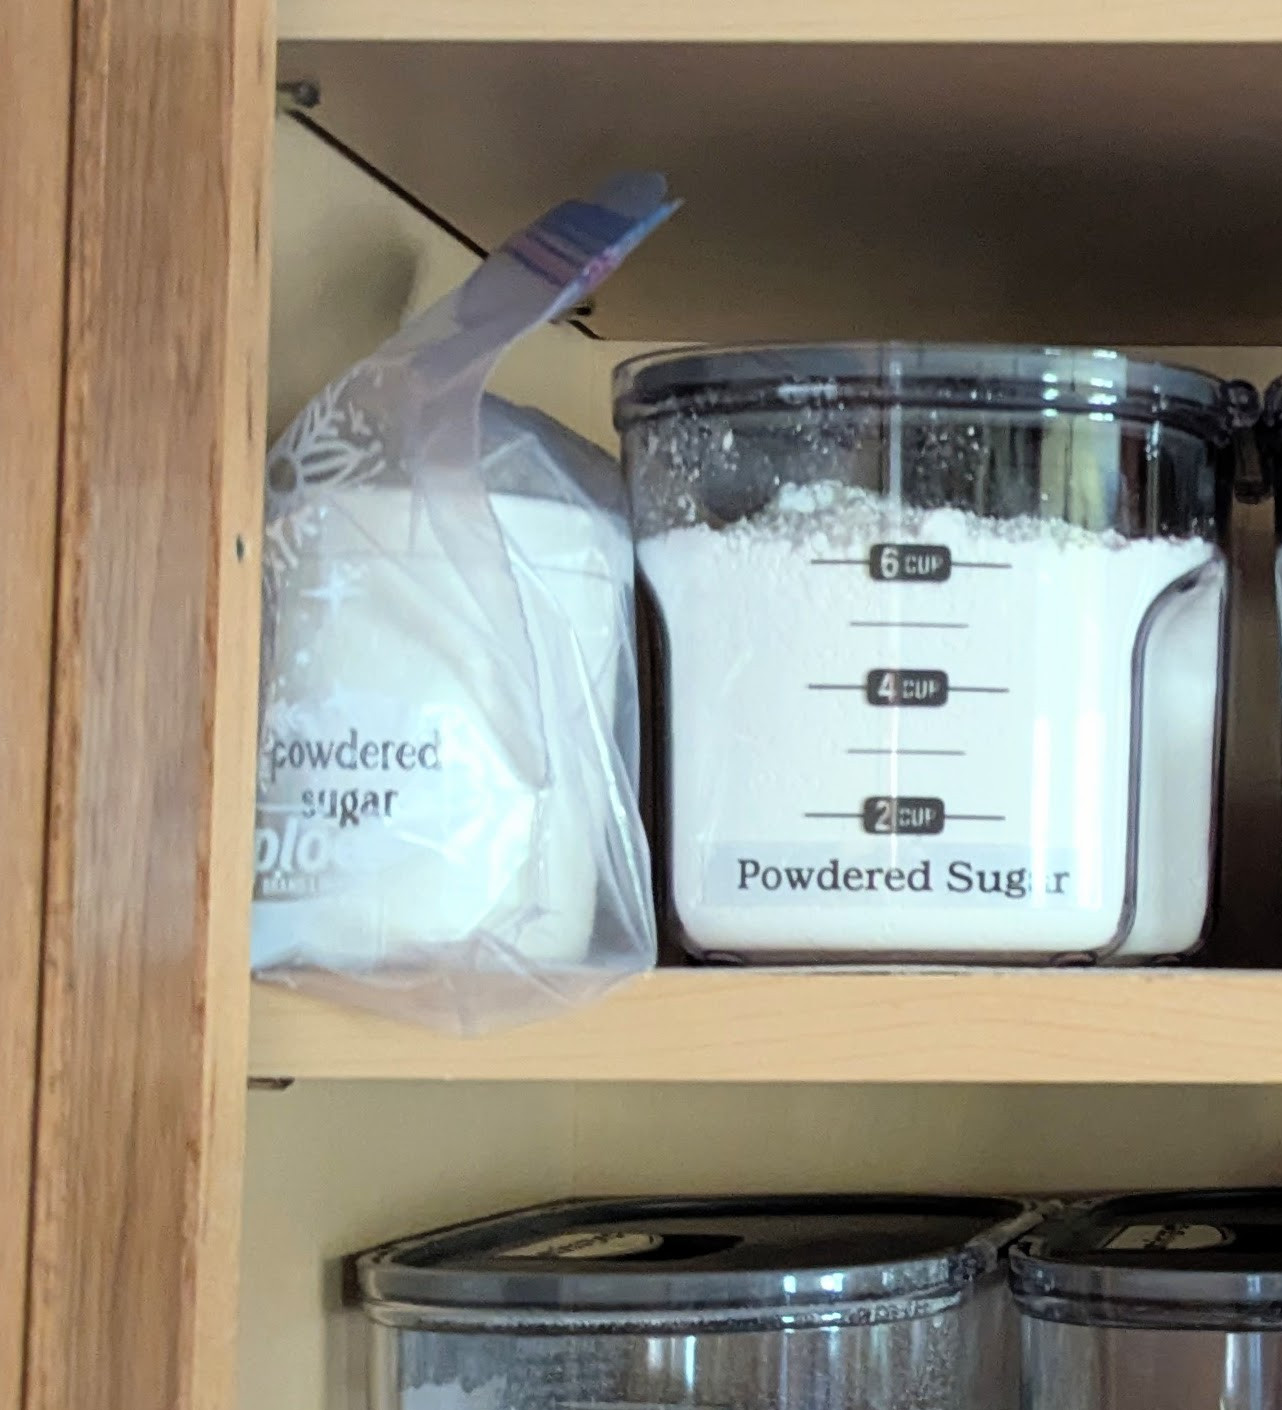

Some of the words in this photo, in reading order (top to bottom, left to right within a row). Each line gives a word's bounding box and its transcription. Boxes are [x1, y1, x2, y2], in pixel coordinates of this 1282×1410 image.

[880, 548, 899, 578] 6
[904, 556, 941, 575] CUP
[877, 672, 897, 703] 4
[903, 680, 940, 700] CUP
[271, 727, 441, 785] powdered
[301, 788, 398, 828] sugar
[874, 800, 895, 831] 2
[900, 808, 938, 828] CUP
[738, 858, 933, 892] Powdered
[947, 860, 1070, 899] Sugr
